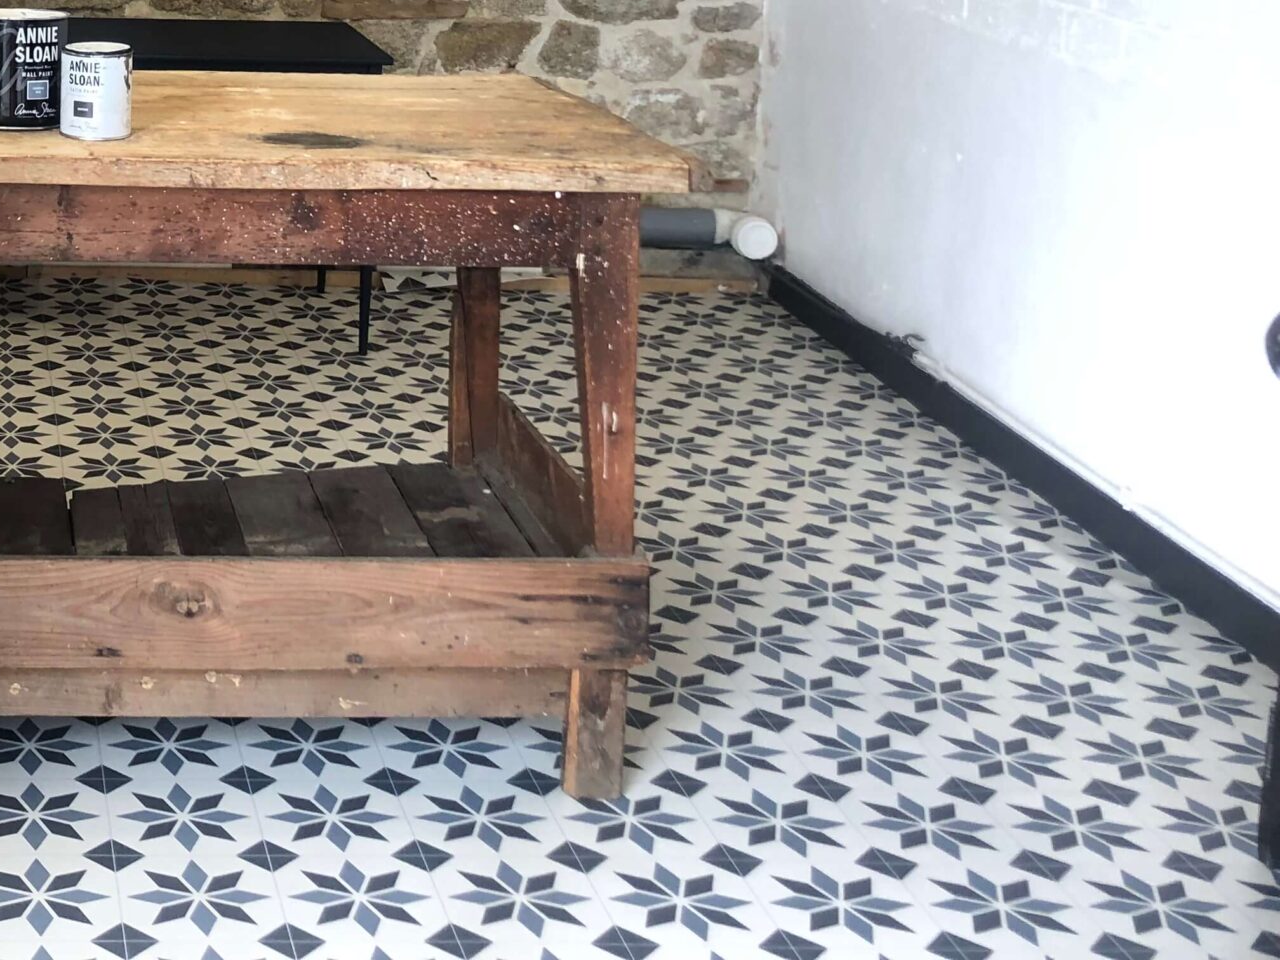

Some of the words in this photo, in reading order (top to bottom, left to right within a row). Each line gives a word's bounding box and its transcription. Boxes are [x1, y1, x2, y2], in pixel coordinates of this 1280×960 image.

[16, 26, 59, 44] ANNIE
[15, 45, 59, 63] SLOAN
[38, 70, 54, 78] PAINT
[69, 60, 101, 74] ANNIE
[69, 73, 101, 87] SLOAN
